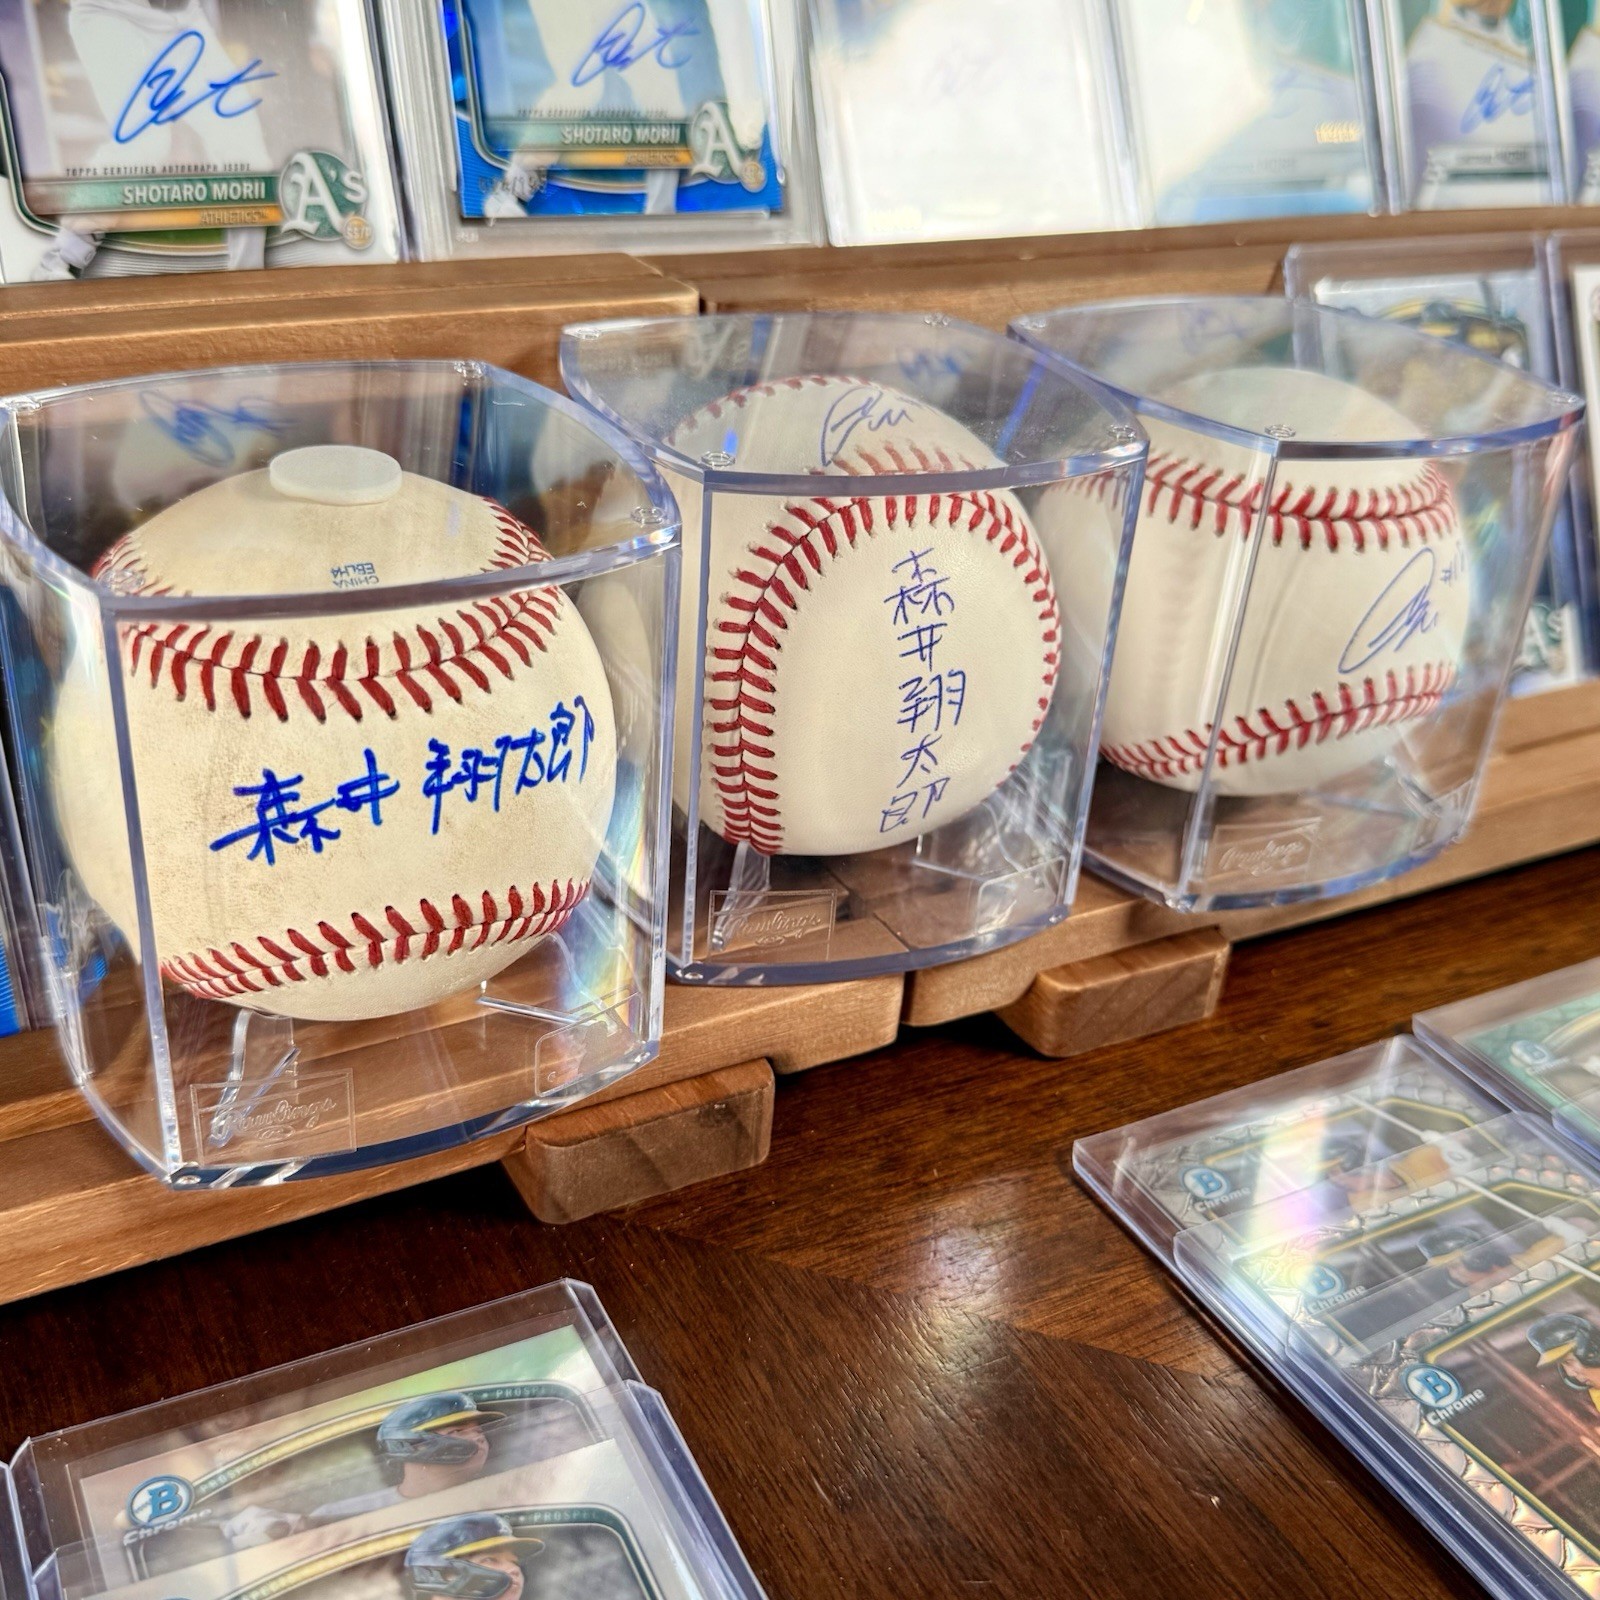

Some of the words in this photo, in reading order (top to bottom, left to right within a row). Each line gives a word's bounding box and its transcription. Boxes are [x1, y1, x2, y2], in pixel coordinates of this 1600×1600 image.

[562, 124, 632, 145] SHOTARO
[103, 165, 157, 176] CERTIFIED
[123, 182, 207, 205] SHOTARO
[212, 181, 266, 200] MORII
[332, 575, 380, 589] CHINA
[1194, 1187, 1251, 1213] Chrome
[1307, 1284, 1367, 1314] Chrome
[1426, 1388, 1486, 1426] Chrome
[123, 1508, 212, 1546] Chrome
